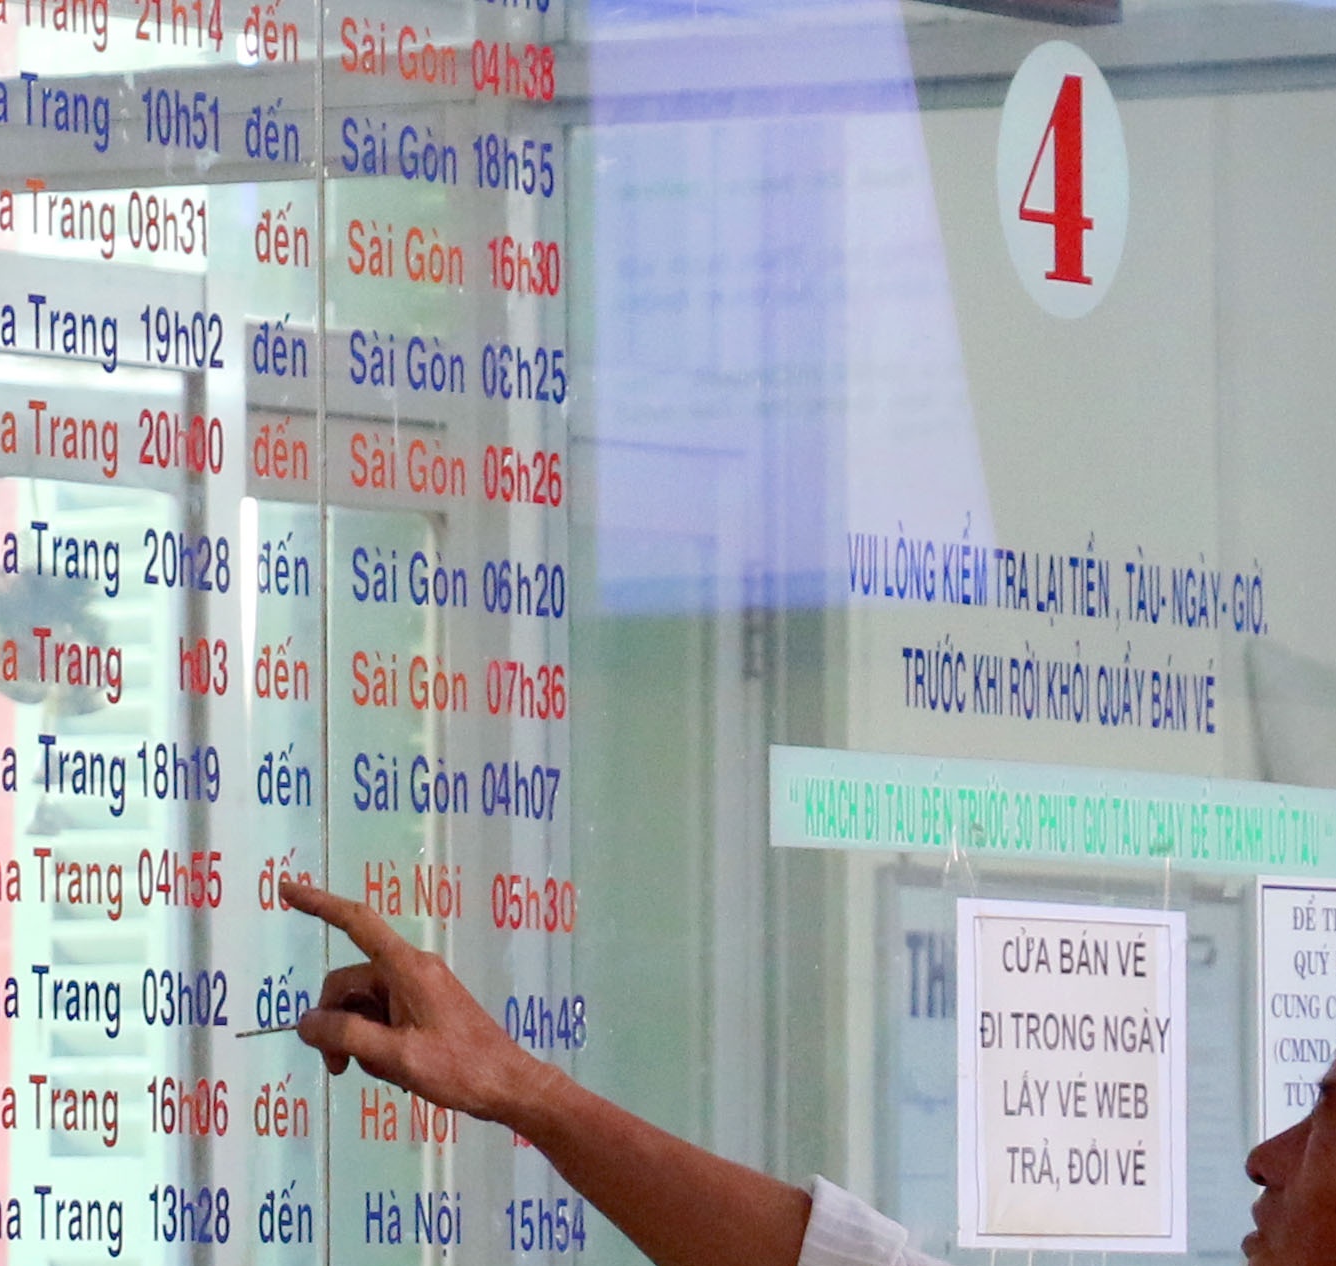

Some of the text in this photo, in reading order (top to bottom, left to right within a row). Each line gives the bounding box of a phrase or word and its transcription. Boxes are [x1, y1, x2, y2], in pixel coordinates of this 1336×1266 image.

[20, 69, 112, 153] Trang
[142, 88, 220, 153] 10h51
[245, 98, 300, 165] đến
[342, 116, 390, 176] Sài
[400, 121, 456, 188] Gòn
[473, 130, 554, 198] 18h55
[1019, 74, 1093, 285] 4
[31, 521, 121, 598] Trang
[143, 527, 230, 594] 20h28
[258, 533, 311, 598] đến
[352, 546, 400, 605] Sài
[410, 552, 467, 609] Gòn
[482, 560, 564, 619] 06h20
[848, 532, 878, 595] VUI
[884, 520, 935, 601] LÒNG
[943, 511, 988, 606] KIỂM
[994, 547, 1029, 611] TRA
[1036, 552, 1063, 626] LẠI
[902, 634, 1215, 734] TRƯỚC KHI RỜI KHỎI QUẦY BÁN VÉ
[38, 734, 126, 817] Trang
[136, 742, 220, 802] 18h19
[258, 749, 312, 808] đến
[354, 752, 402, 814] Sài
[410, 755, 469, 816] Gòn
[482, 760, 560, 821] 04h07
[1060, 930, 1109, 976] BÁN
[1117, 932, 1146, 978] VÉ
[980, 1007, 1170, 1053] ĐI TRONG NGÀY
[1003, 1070, 1149, 1119] LẤY VÉ WEB
[1068, 1138, 1109, 1185] ĐỔI
[1117, 1141, 1146, 1186] VÉ
[34, 1185, 124, 1257] Trang
[151, 1184, 230, 1245] 13h28
[259, 1179, 312, 1245] đến
[365, 1192, 403, 1246] Hà
[413, 1190, 462, 1255] Nội
[507, 1199, 586, 1252] 15h54
